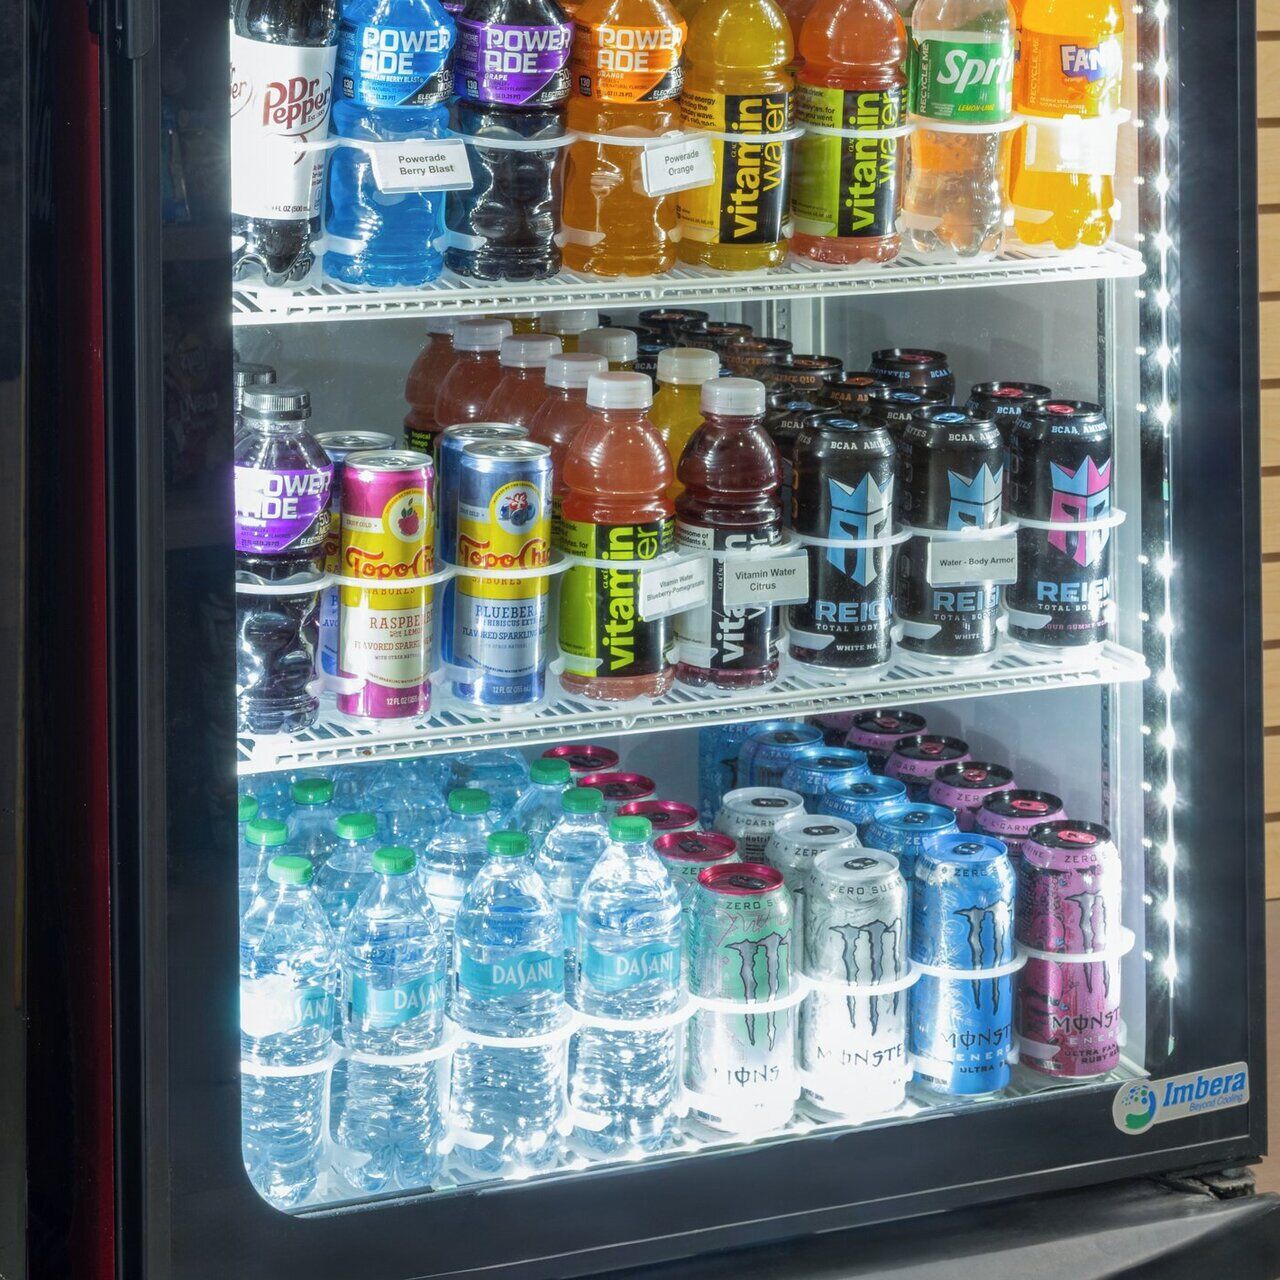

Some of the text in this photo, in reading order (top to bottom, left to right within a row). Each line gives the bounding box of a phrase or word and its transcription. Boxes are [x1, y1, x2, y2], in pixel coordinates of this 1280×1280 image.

[363, 27, 450, 53] POWER
[486, 28, 572, 51] POWER
[598, 27, 683, 51] POWER
[361, 51, 415, 74] ADE
[484, 51, 538, 74] ADE
[596, 50, 650, 73] ADE
[484, 73, 508, 82] GRAPE
[920, 42, 930, 113] RECYCLE ME
[288, 76, 320, 103] Dr
[262, 82, 330, 130] Pepper
[399, 154, 446, 164] Powerade
[665, 150, 699, 165] Powerade
[727, 98, 763, 238] vitamin
[845, 93, 880, 231] vitamin
[400, 165, 455, 177] Berry Blast
[668, 163, 694, 177] Orange
[949, 433, 975, 442] BCAA
[1051, 422, 1108, 434] BCAA AMINOS
[830, 441, 858, 450] BCAA
[459, 534, 518, 569] Topo
[939, 558, 962, 567] Water
[969, 557, 988, 566] Body
[990, 556, 1015, 565] Armor
[346, 546, 413, 581] Topo
[735, 567, 796, 580] Vitamin Water
[646, 580, 705, 601] Blueberry-Pomegranate
[659, 573, 694, 588] Vitamin Water
[750, 582, 777, 591] Citrus
[1036, 578, 1110, 602] REIGN
[597, 525, 635, 672] vitamin
[815, 597, 893, 623] REIGN
[816, 623, 849, 632] TOTAL
[492, 957, 553, 988] DASANI
[616, 949, 674, 979] DASANI
[1162, 1070, 1247, 1107] Imbera
[1189, 1093, 1244, 1113] Beyond Cooling
